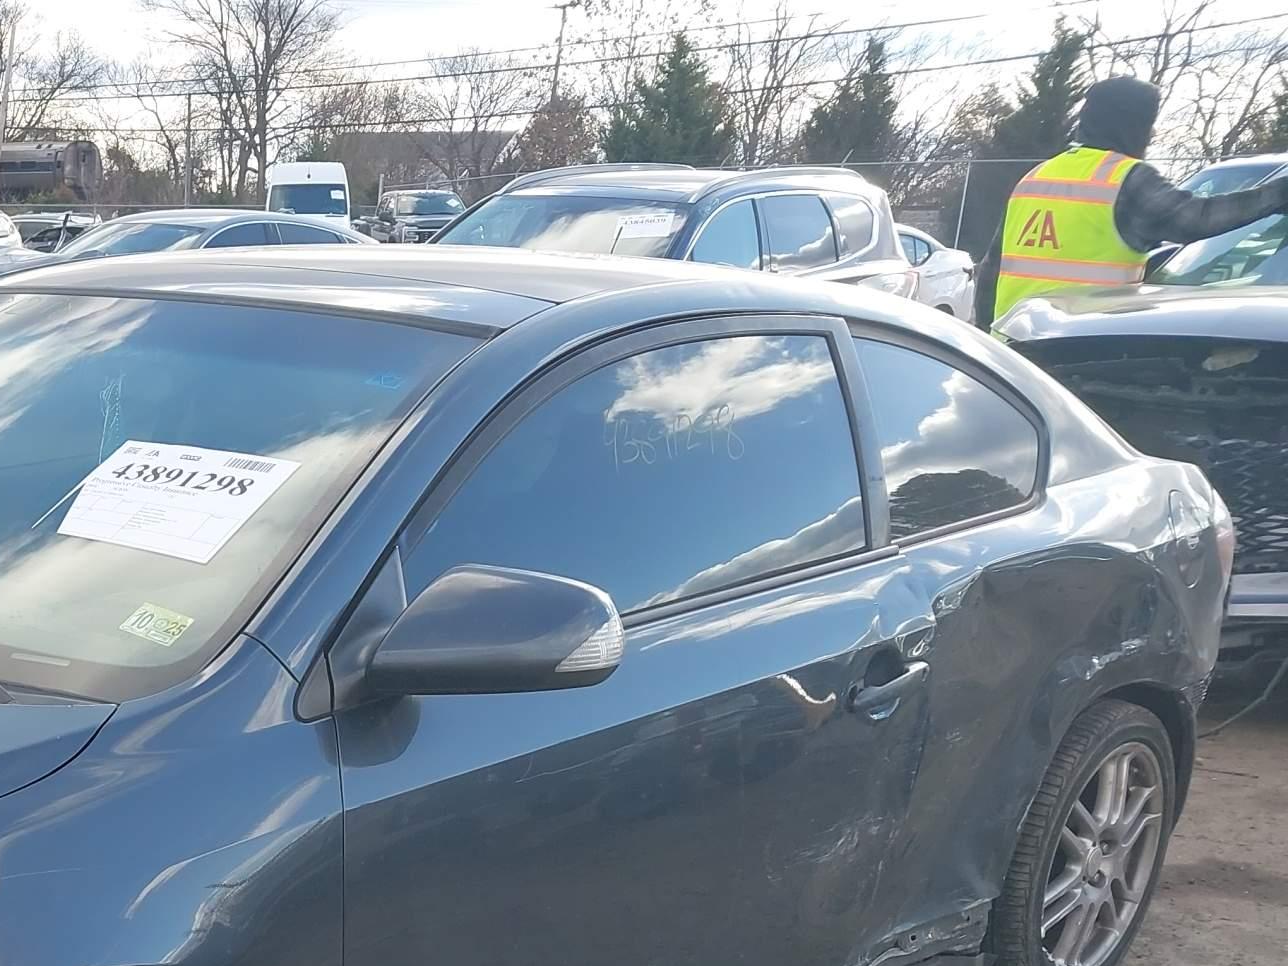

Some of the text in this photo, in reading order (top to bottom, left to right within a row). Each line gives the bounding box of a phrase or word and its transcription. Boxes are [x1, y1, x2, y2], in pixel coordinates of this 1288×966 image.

[112, 462, 254, 497] 43891298
[131, 609, 188, 636] 10 25
